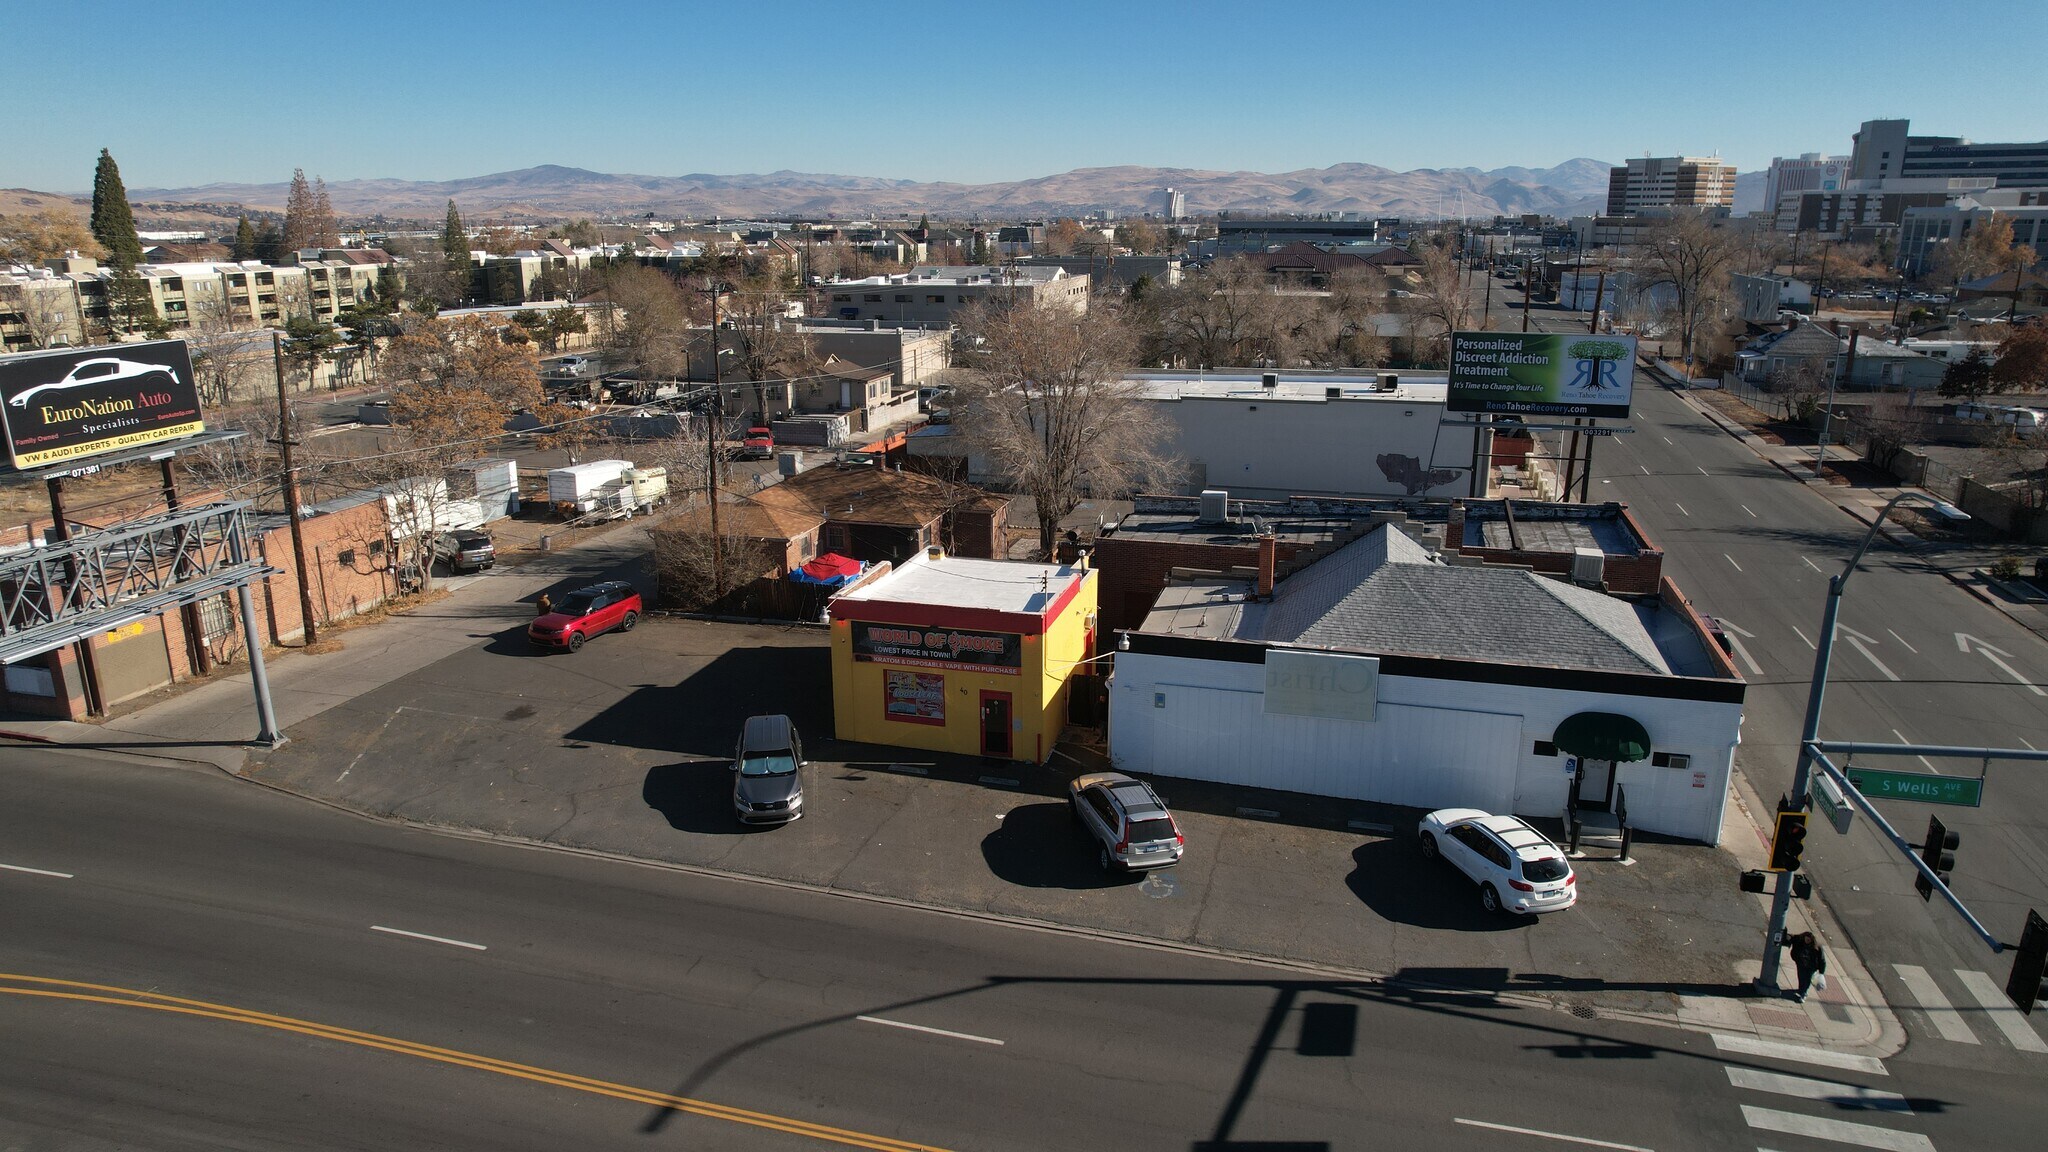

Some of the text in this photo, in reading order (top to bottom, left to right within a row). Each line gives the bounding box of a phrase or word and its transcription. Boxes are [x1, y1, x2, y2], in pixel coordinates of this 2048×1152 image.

[1456, 338, 1523, 351] Personalized
[1455, 350, 1549, 365] Discreet Addiction
[1454, 364, 1509, 376] Treatment
[1465, 382, 1481, 390] Time
[1490, 382, 1515, 392] Change
[1531, 384, 1544, 392] Life
[40, 391, 172, 425] EuroNation Auto
[1486, 401, 1588, 414] RenoTahoeRecovery.com
[82, 417, 140, 434] Specialists
[1584, 429, 1610, 437] 003291
[24, 453, 41, 463] VW
[51, 449, 72, 459] AUDI
[74, 441, 111, 454] EXPERTS
[118, 432, 151, 445] QUALITY
[152, 429, 169, 438] CAR
[169, 424, 195, 434] REPAIR
[71, 464, 101, 478] 071381
[867, 627, 922, 646] WORLD
[924, 632, 947, 649] OF
[874, 646, 900, 654] LOWEST
[901, 648, 920, 656] PRICE
[930, 650, 951, 659] TOWN!
[873, 656, 901, 664] KRATOM
[906, 660, 944, 669] DISPOSABLE
[945, 663, 961, 671] VAPE
[981, 666, 1018, 675] PURCHASE
[1882, 780, 1890, 791] S
[1898, 781, 1939, 796] Wells
[1944, 783, 1961, 792] AVE
